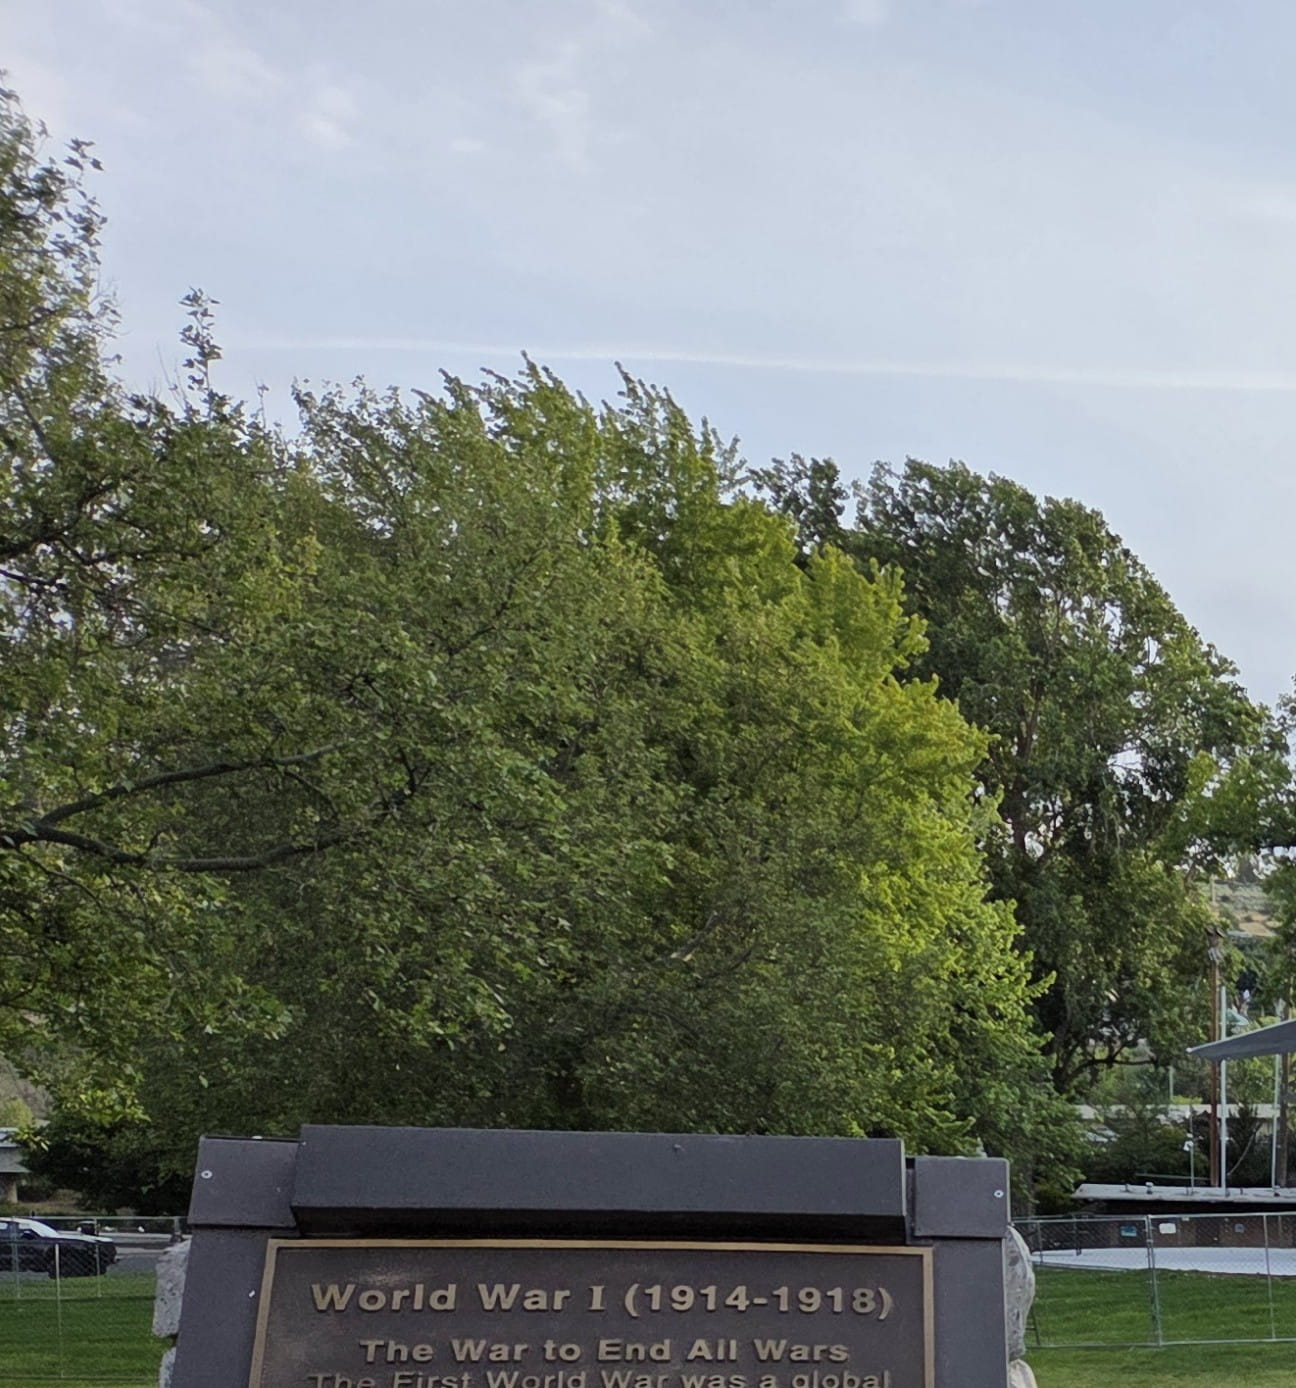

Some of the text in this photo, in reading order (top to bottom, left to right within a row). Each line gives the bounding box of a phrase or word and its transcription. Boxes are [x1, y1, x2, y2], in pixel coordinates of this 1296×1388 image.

[312, 1281, 893, 1317] World War I (1914-1918)
[359, 1338, 850, 1362] The War to End All Wars
